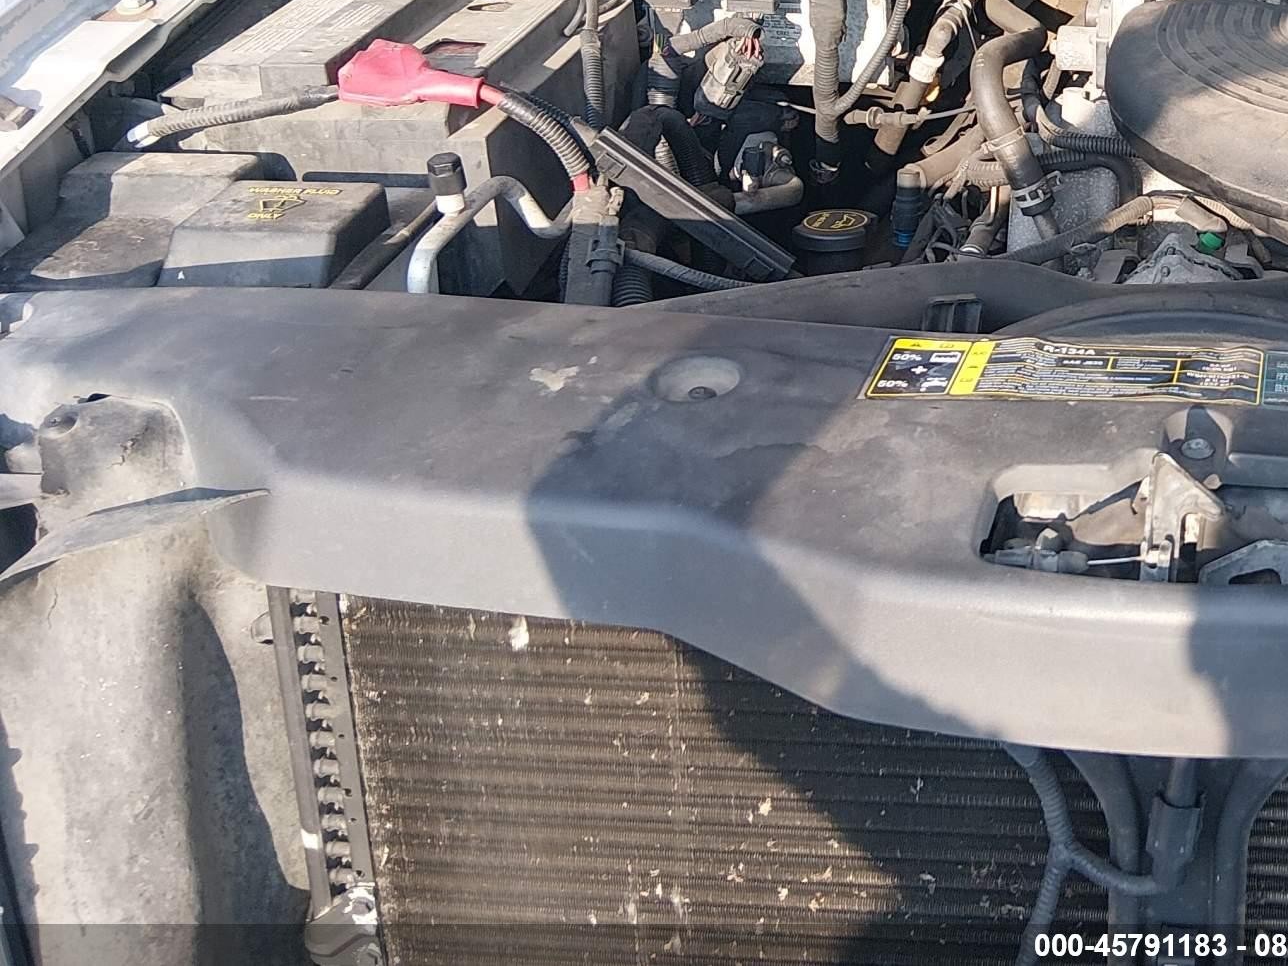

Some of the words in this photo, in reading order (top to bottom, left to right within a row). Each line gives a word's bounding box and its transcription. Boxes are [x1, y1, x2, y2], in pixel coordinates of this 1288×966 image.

[303, 187, 341, 195] FLUID
[1042, 345, 1096, 355] R-134A
[891, 352, 923, 361] 50%
[876, 379, 909, 388] 50%
